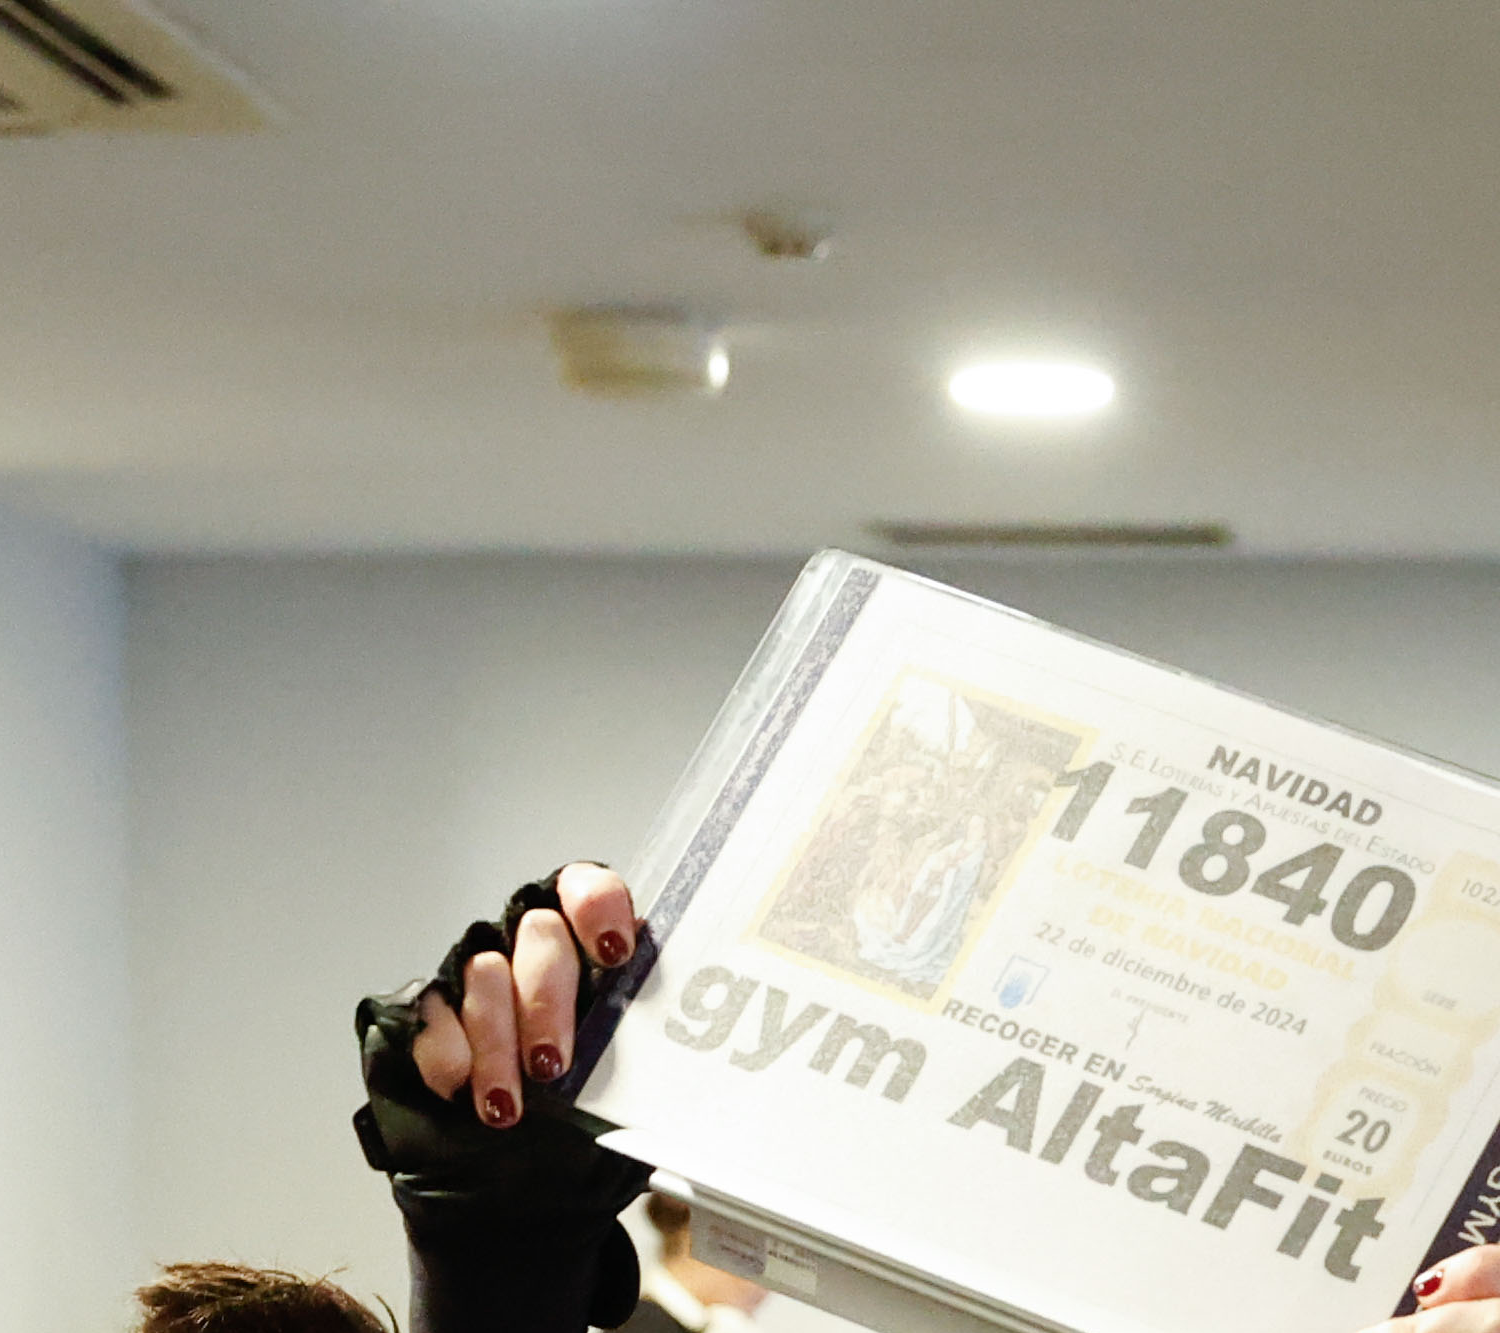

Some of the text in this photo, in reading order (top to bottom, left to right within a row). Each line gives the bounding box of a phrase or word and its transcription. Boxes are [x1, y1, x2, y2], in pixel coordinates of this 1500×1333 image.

[1206, 745, 1383, 827] NAVIDAD
[1051, 760, 1417, 952] 11840
[1033, 922, 1309, 1036] 22 de diciembre de 2024
[1088, 903, 1290, 991] DE NAVIDAD
[1201, 905, 1358, 982] NACIONAL
[941, 998, 1127, 1083] RECOGER EN
[663, 964, 1387, 1283] gym AltaFit
[1334, 1108, 1391, 1154] 20
